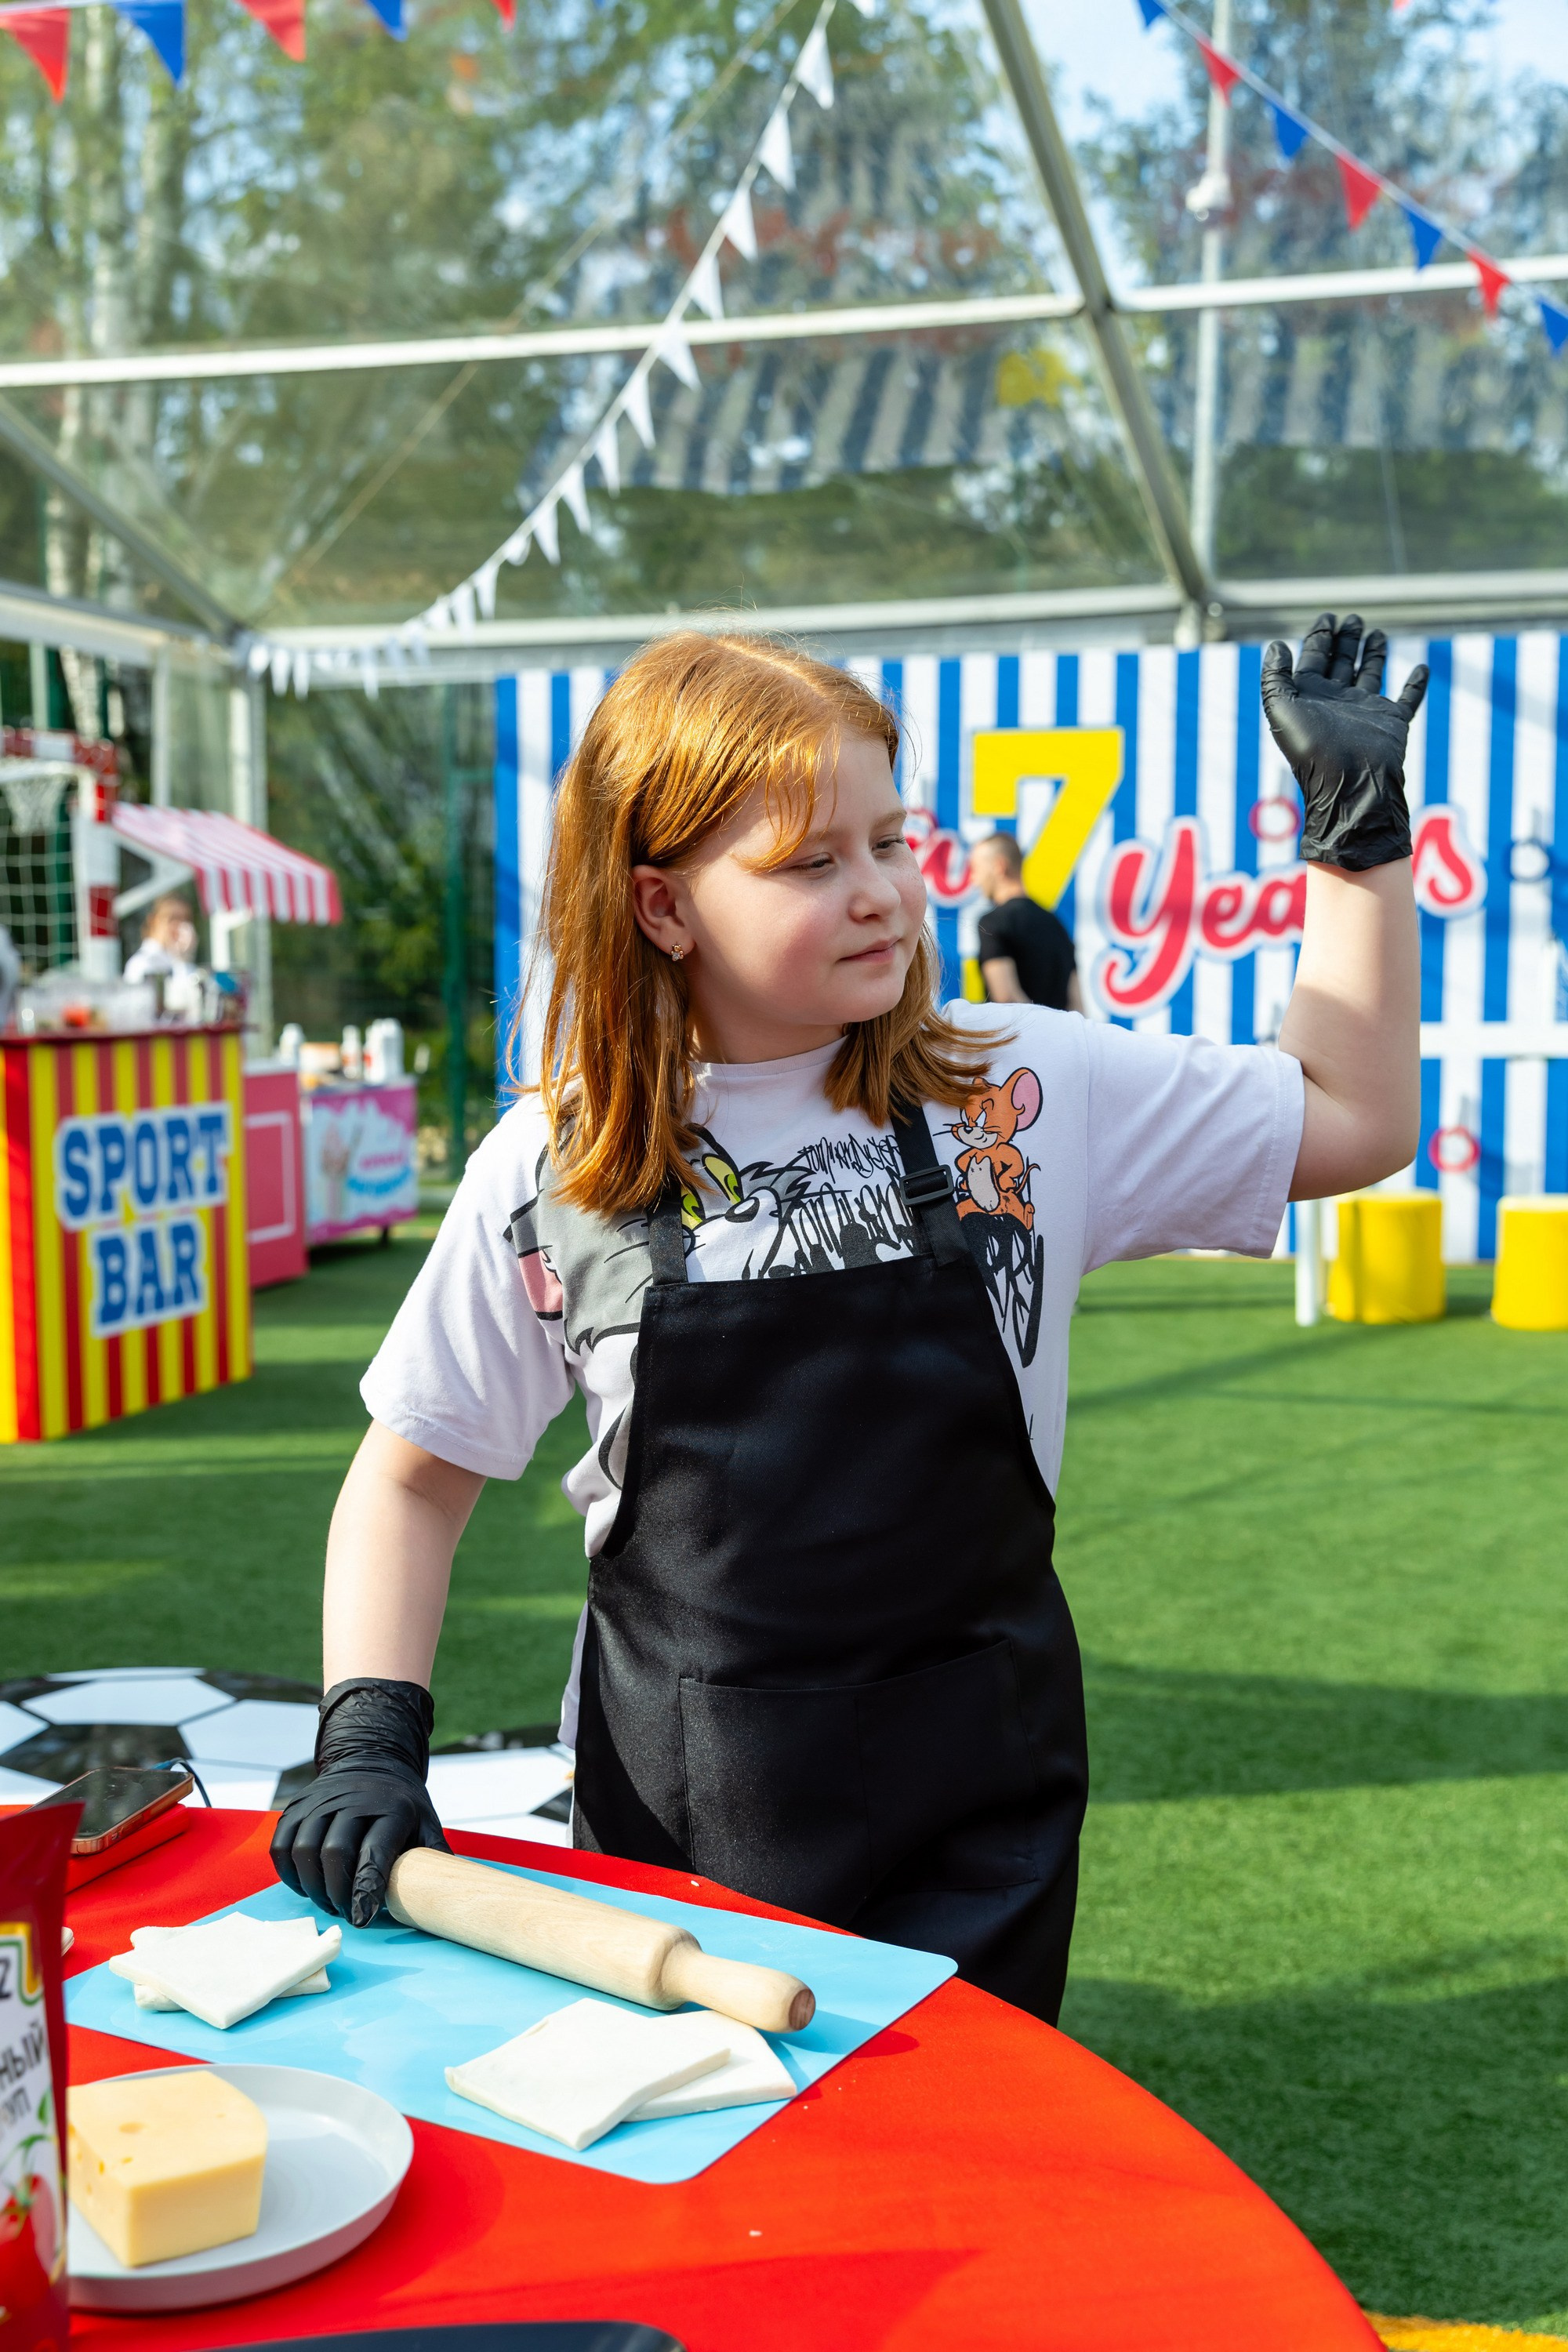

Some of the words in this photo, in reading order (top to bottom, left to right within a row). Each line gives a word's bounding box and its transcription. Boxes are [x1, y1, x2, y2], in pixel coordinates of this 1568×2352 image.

[1103, 815, 1474, 1007] Yeas
[60, 1110, 227, 1220] SPORT
[96, 1221, 201, 1327] BAR
